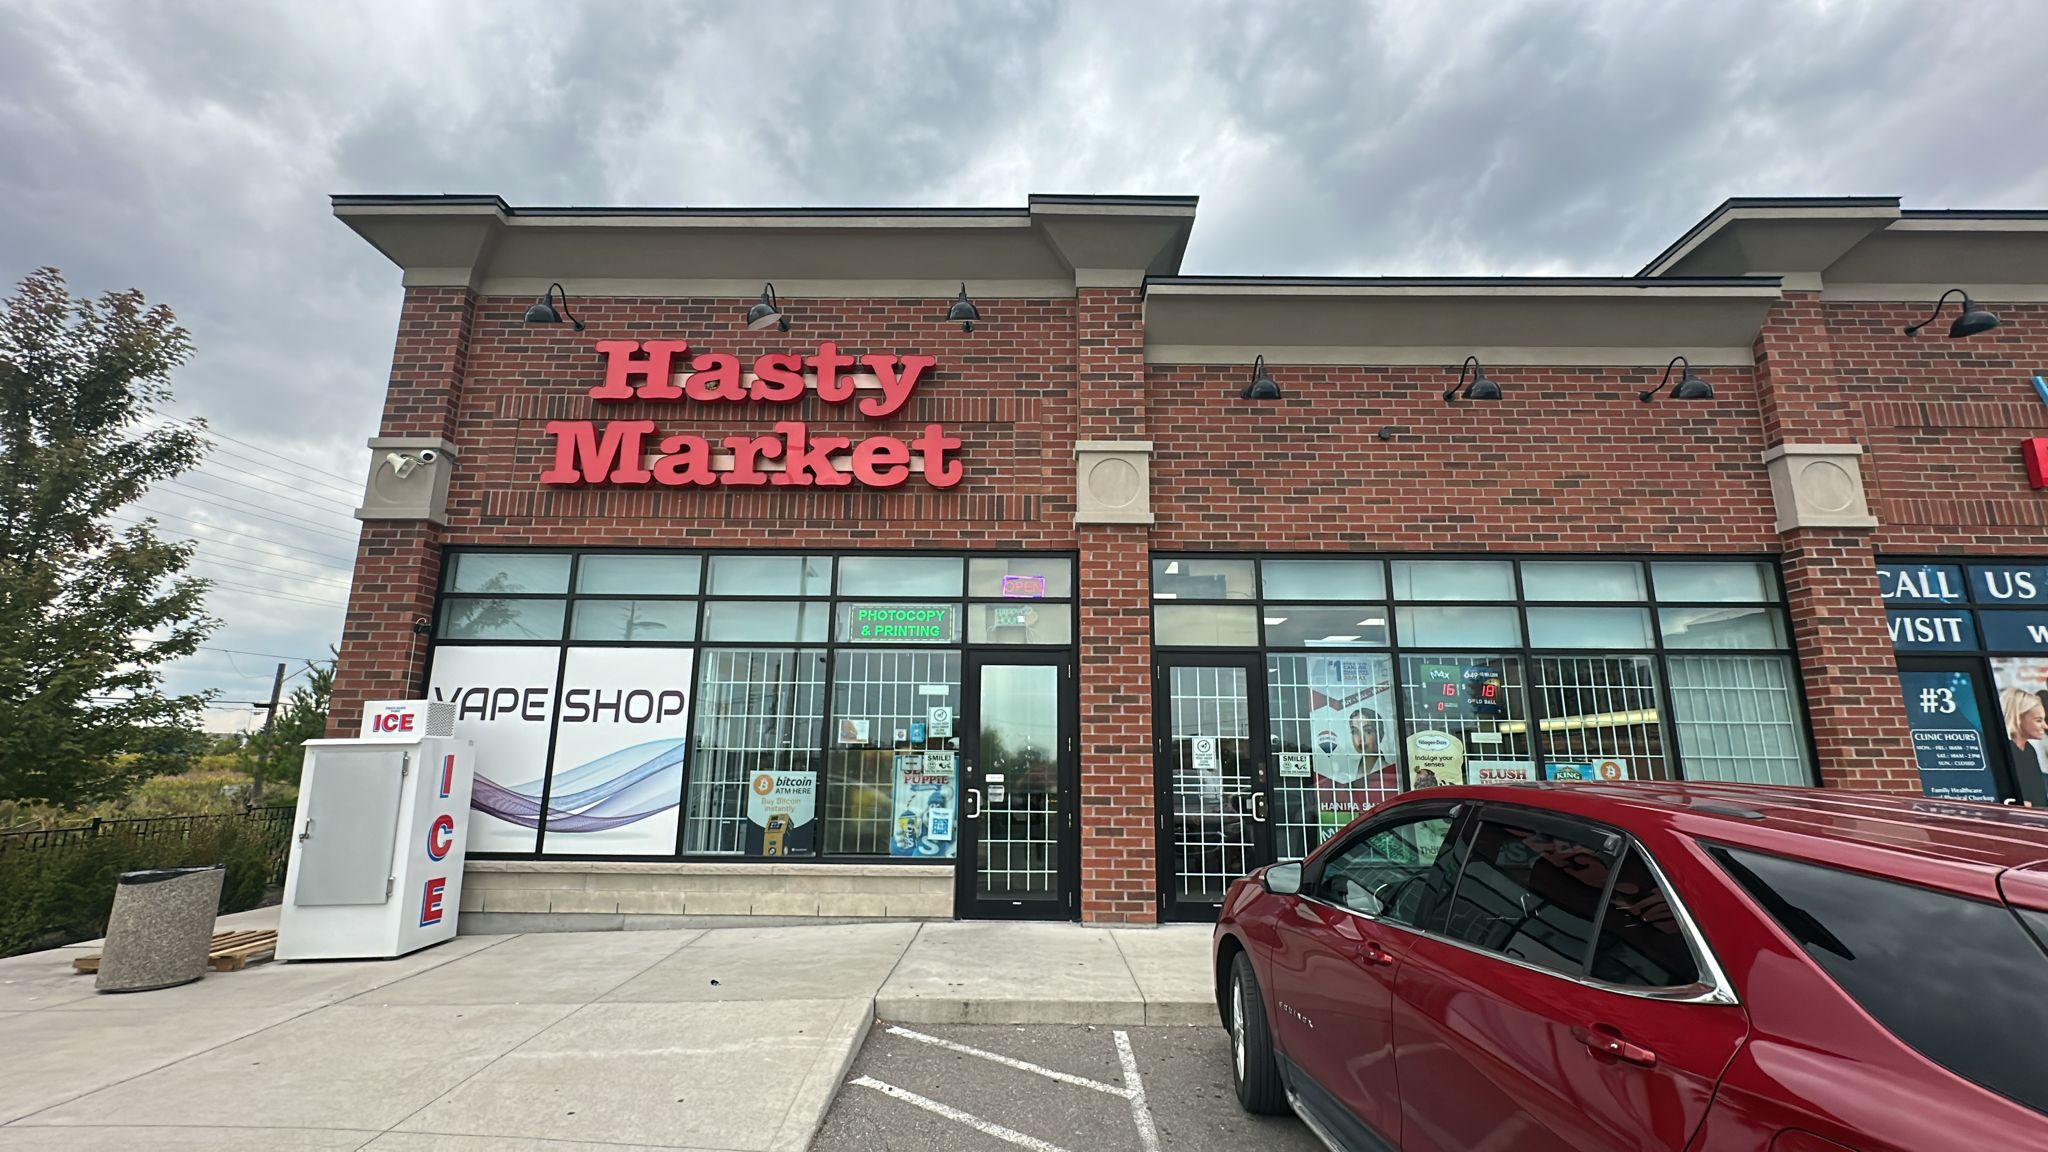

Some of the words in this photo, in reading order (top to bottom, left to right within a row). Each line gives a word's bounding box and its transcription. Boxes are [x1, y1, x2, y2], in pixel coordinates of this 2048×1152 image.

[588, 338, 937, 419] Hasty
[540, 420, 965, 490] Market
[1004, 580, 1044, 593] OPEN
[1876, 571, 1959, 598] CALL
[1984, 571, 2037, 599] US
[858, 609, 945, 622] PHOTOCOPY
[860, 625, 871, 637] &
[875, 625, 941, 637] PRINTING
[1887, 617, 1963, 642] VISIT
[1464, 670, 1478, 679] 649
[1443, 683, 1456, 696] 16
[1482, 685, 1495, 697] 18
[562, 688, 685, 724] SHOP
[1919, 688, 1957, 713] #3
[373, 713, 415, 732] ICE
[1914, 733, 1943, 741] CLINIC
[1944, 733, 1976, 741] HOURS
[904, 775, 950, 785] PUPPIE
[1479, 768, 1527, 780] SLUSH
[775, 776, 812, 787] bitcoin
[761, 797, 775, 805] Buy
[764, 804, 795, 812] instantly
[419, 754, 455, 928] ICE
